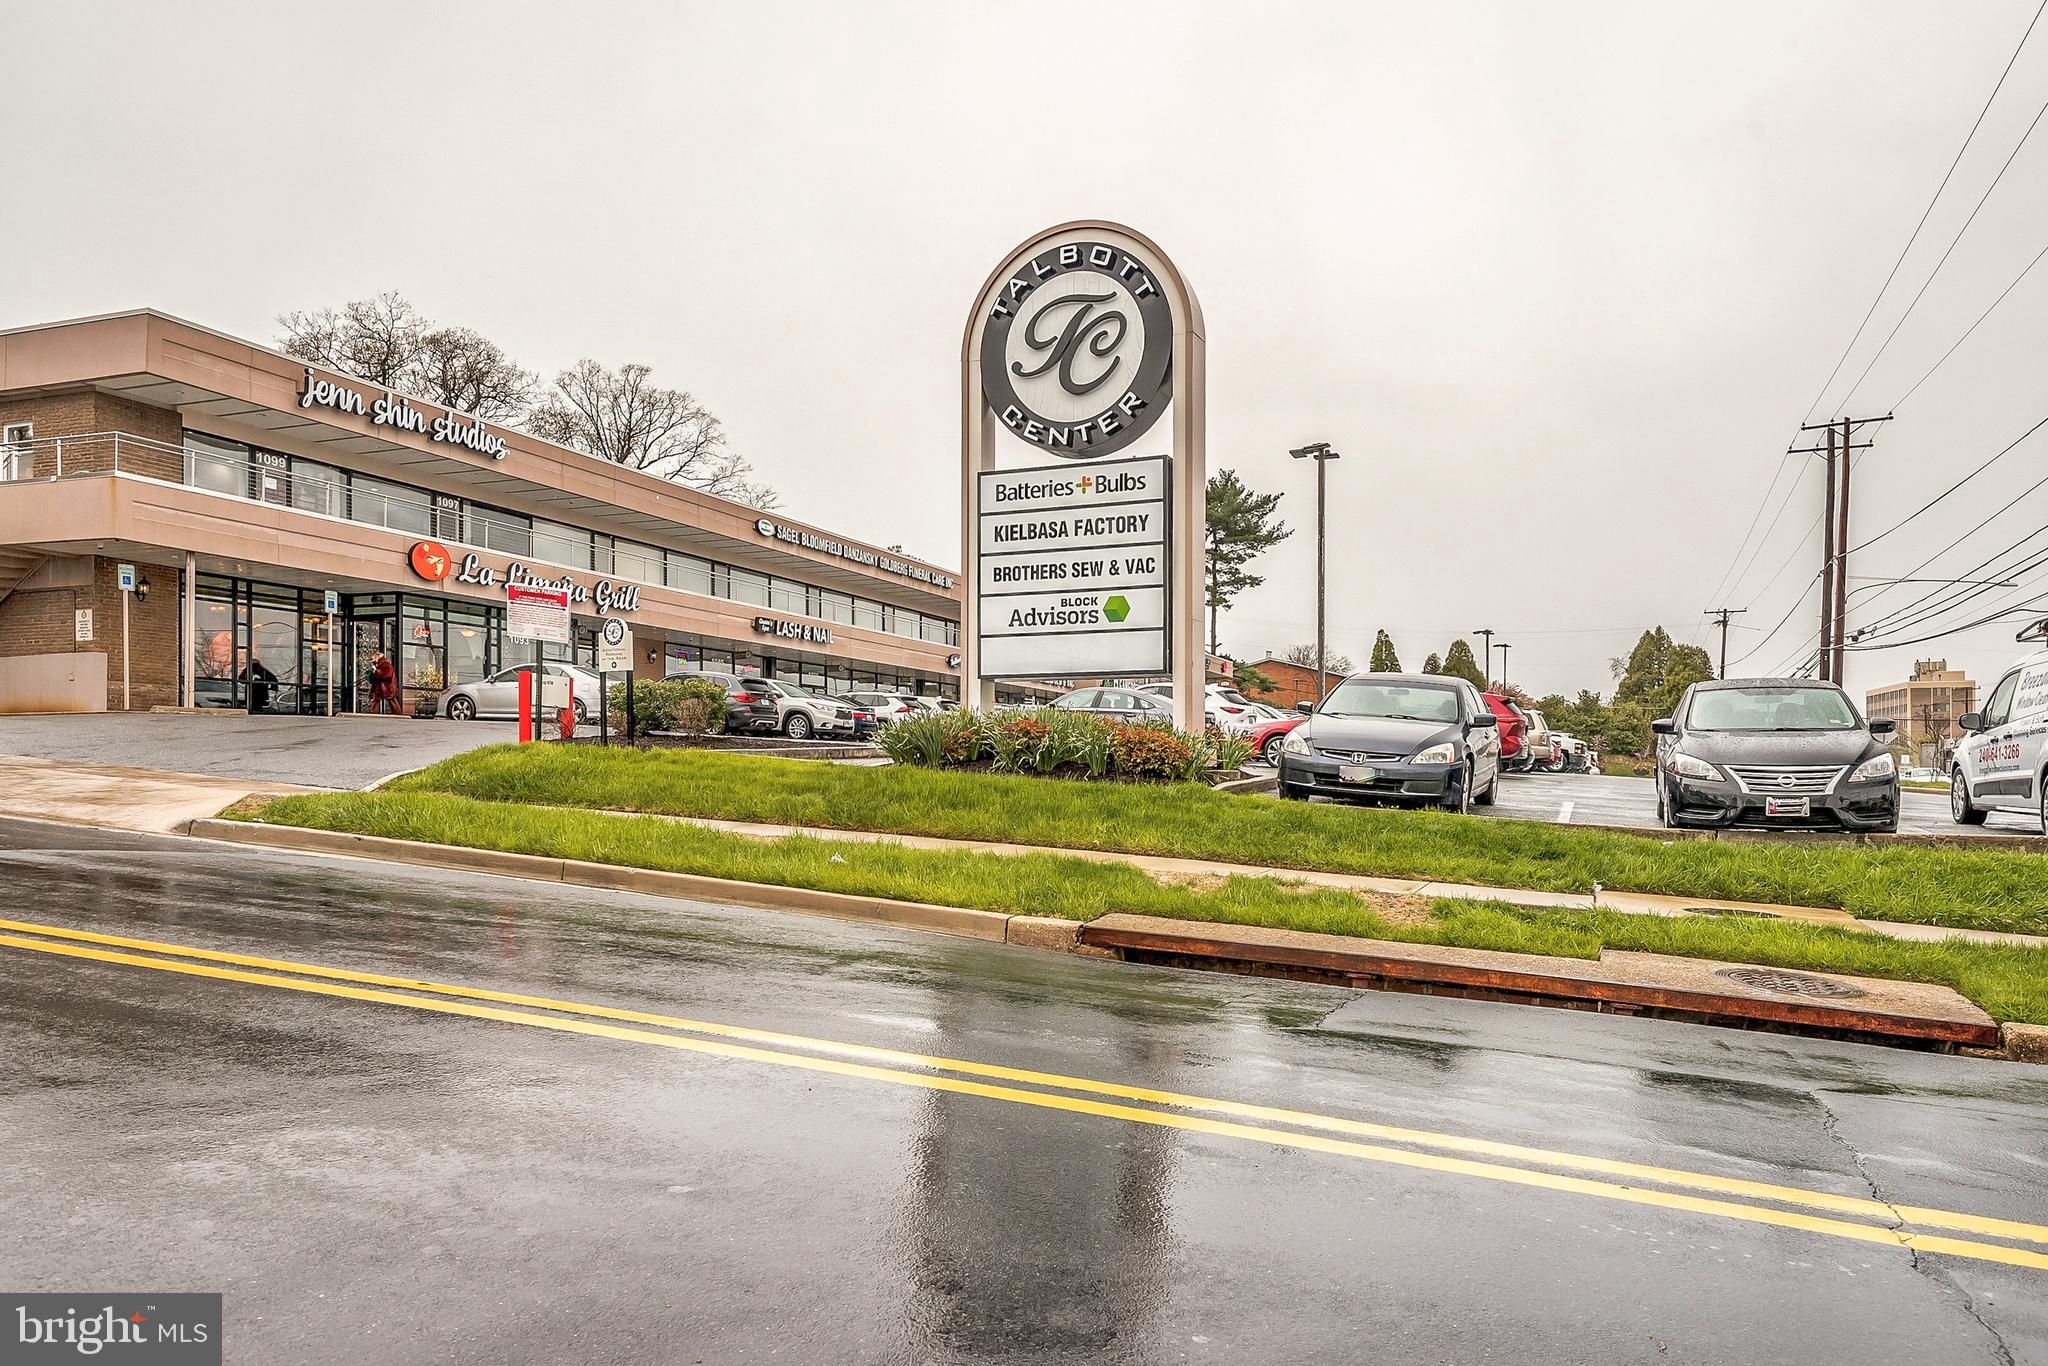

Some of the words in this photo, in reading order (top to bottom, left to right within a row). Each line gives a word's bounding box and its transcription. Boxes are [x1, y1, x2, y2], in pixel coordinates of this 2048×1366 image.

[989, 244, 1158, 317] TALBOTT
[300, 368, 366, 415] jenn
[372, 391, 427, 433] shin
[433, 411, 511, 460] studios
[1001, 391, 1146, 447] CENTER
[256, 452, 287, 468] 1099
[995, 479, 1074, 502] Batteries
[1095, 473, 1147, 494] Bulbs
[436, 496, 460, 510] 1097
[994, 520, 1069, 542] KIELBASA
[1074, 514, 1150, 536] FACTORY
[776, 525, 800, 544] SAGEL
[801, 532, 843, 556] BLOOMFIELD
[843, 545, 879, 567] DANZANSKY
[880, 556, 908, 576] GOLDBERG
[908, 565, 931, 583] FUNERAL
[931, 572, 945, 586] CARE
[945, 577, 955, 589] INC
[993, 562, 1067, 582] BROTHERS
[1071, 560, 1104, 578] SEW
[1109, 559, 1120, 576] &
[1125, 557, 1156, 574] VAC
[458, 553, 496, 587] La
[595, 579, 641, 615] Grill
[1060, 597, 1099, 607] BLOCK
[1008, 607, 1100, 627] Advisors
[509, 635, 529, 645] 1093
[776, 620, 802, 639] LASH
[803, 624, 811, 640] &
[813, 626, 834, 644] NAIL
[1978, 743, 2020, 763] 240-641-3266
